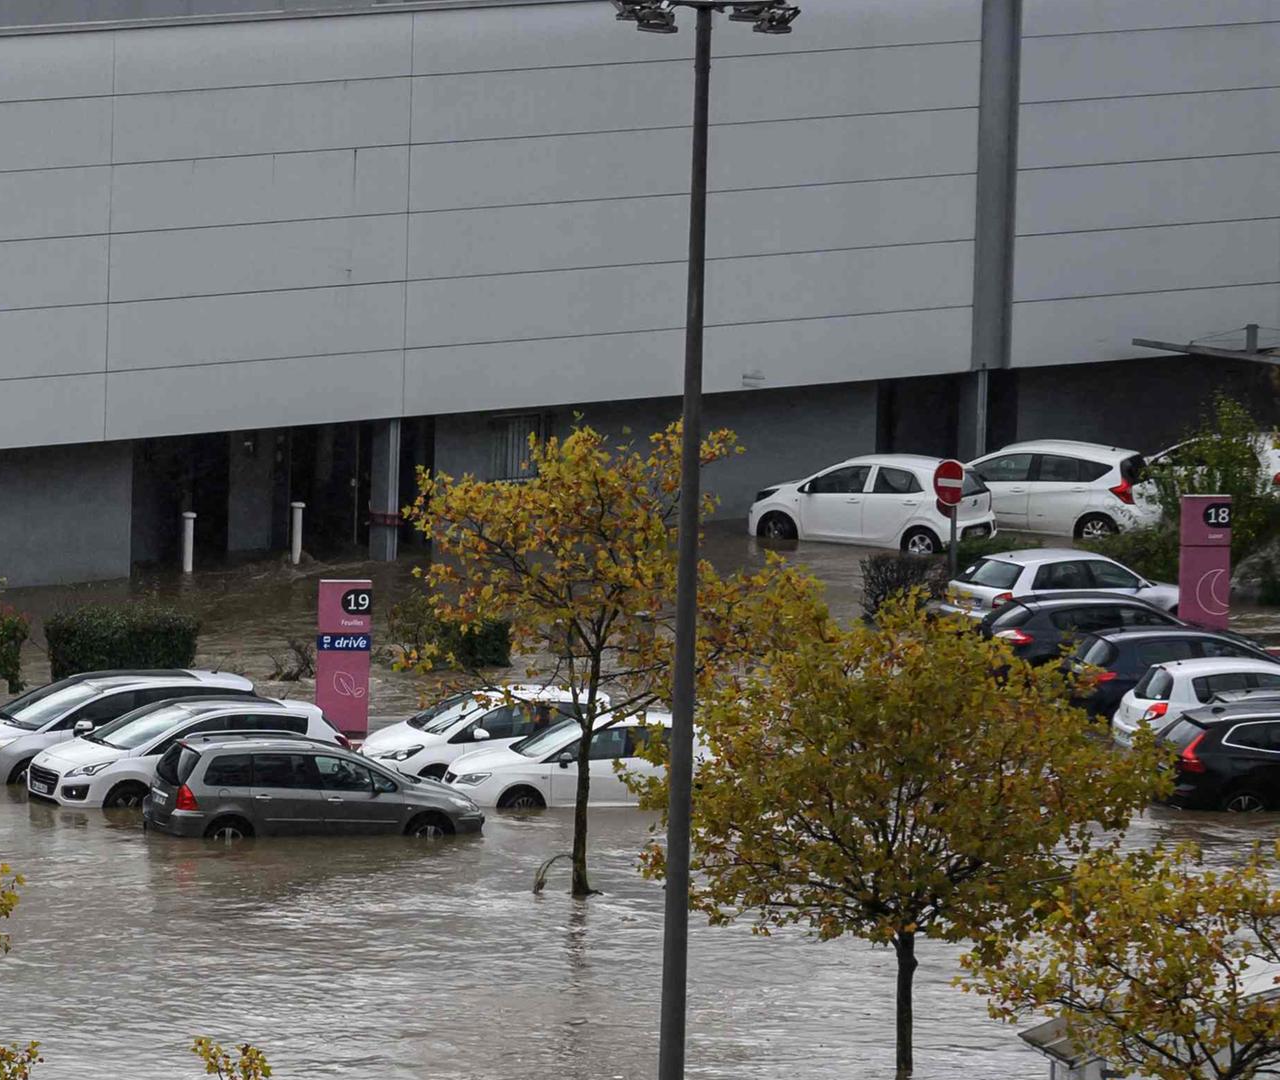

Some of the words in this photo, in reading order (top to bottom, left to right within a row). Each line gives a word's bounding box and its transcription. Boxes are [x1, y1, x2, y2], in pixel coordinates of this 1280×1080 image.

[1208, 508, 1229, 523] 18
[347, 594, 369, 610] 19
[335, 636, 368, 649] drive
